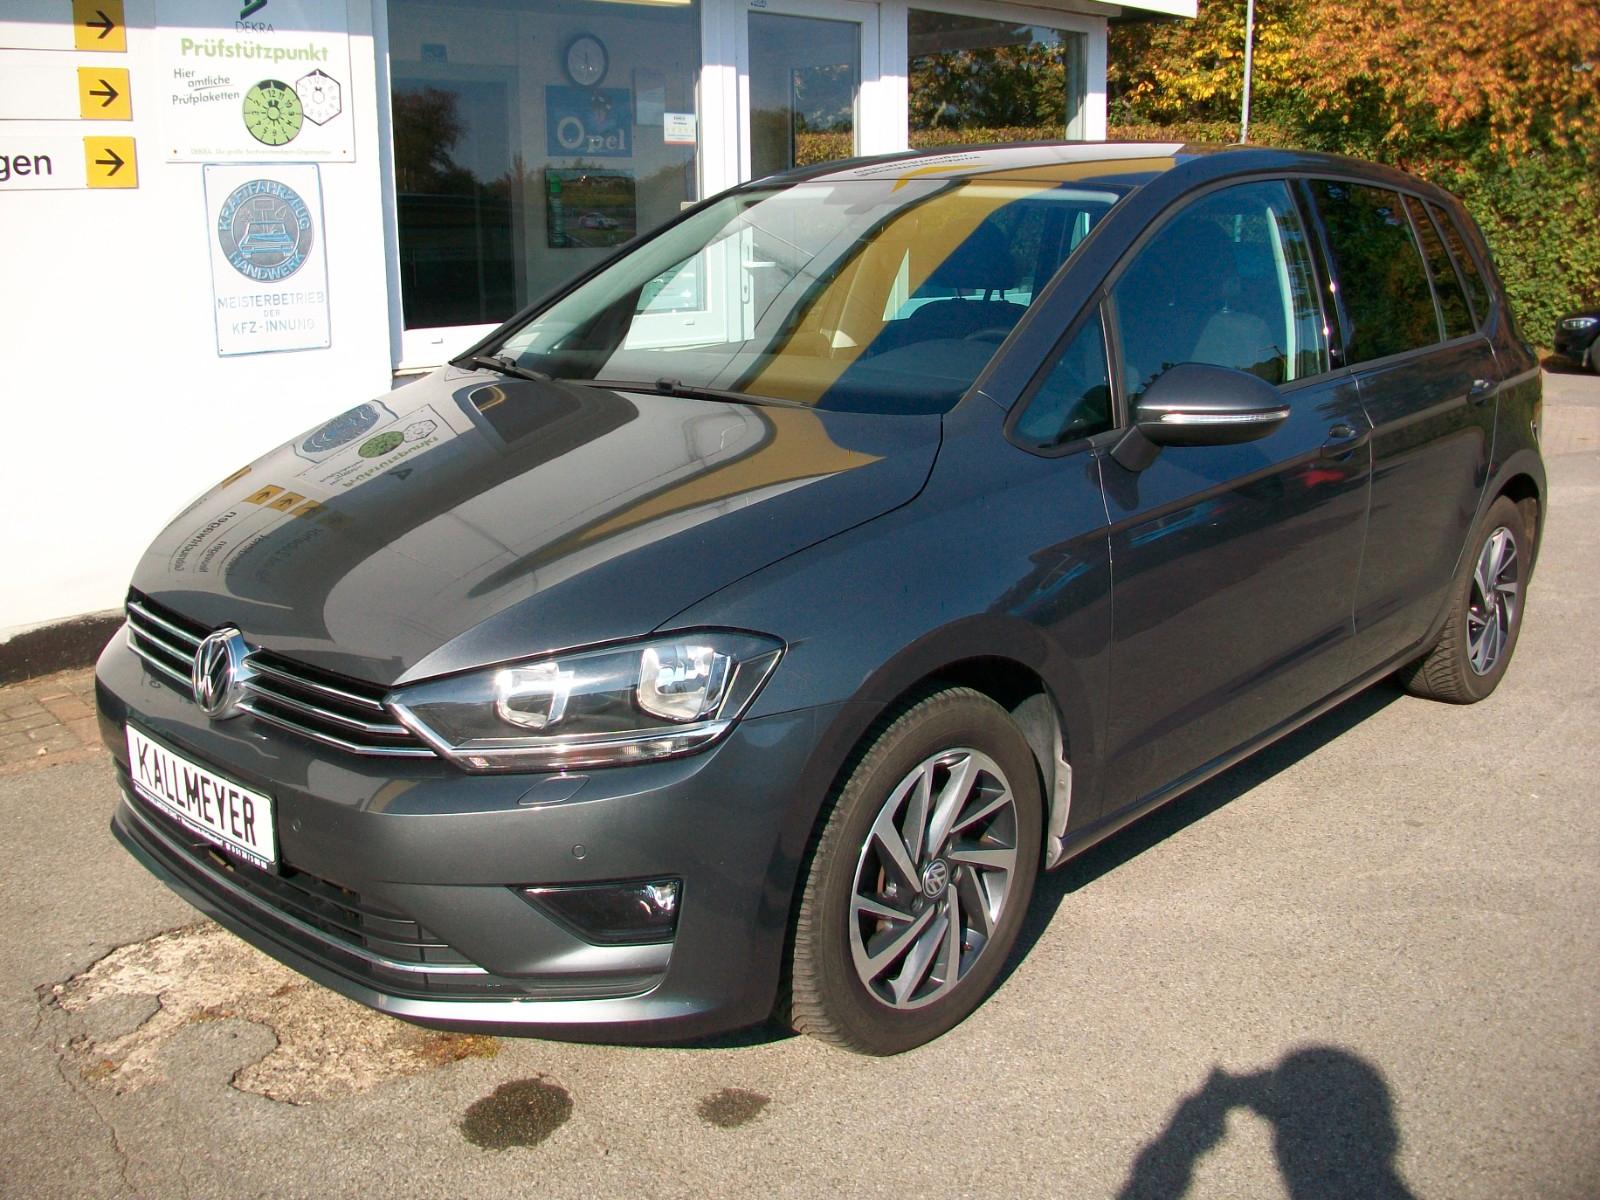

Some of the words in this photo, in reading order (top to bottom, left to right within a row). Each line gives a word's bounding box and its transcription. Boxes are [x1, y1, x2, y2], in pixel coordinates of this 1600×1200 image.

[235, 20, 275, 33] DEKRA
[181, 37, 329, 64] Prüfstützpunkt
[173, 68, 196, 79] Hier
[188, 75, 231, 88] amtliche
[172, 91, 240, 106] Prüfplaketten
[557, 116, 625, 153] Opel
[229, 250, 305, 281] HANDWERK
[217, 291, 325, 309] MEISTERBETRIEB
[232, 319, 315, 336] KFZ-INNUNG
[136, 737, 257, 847] KALLMEYER
